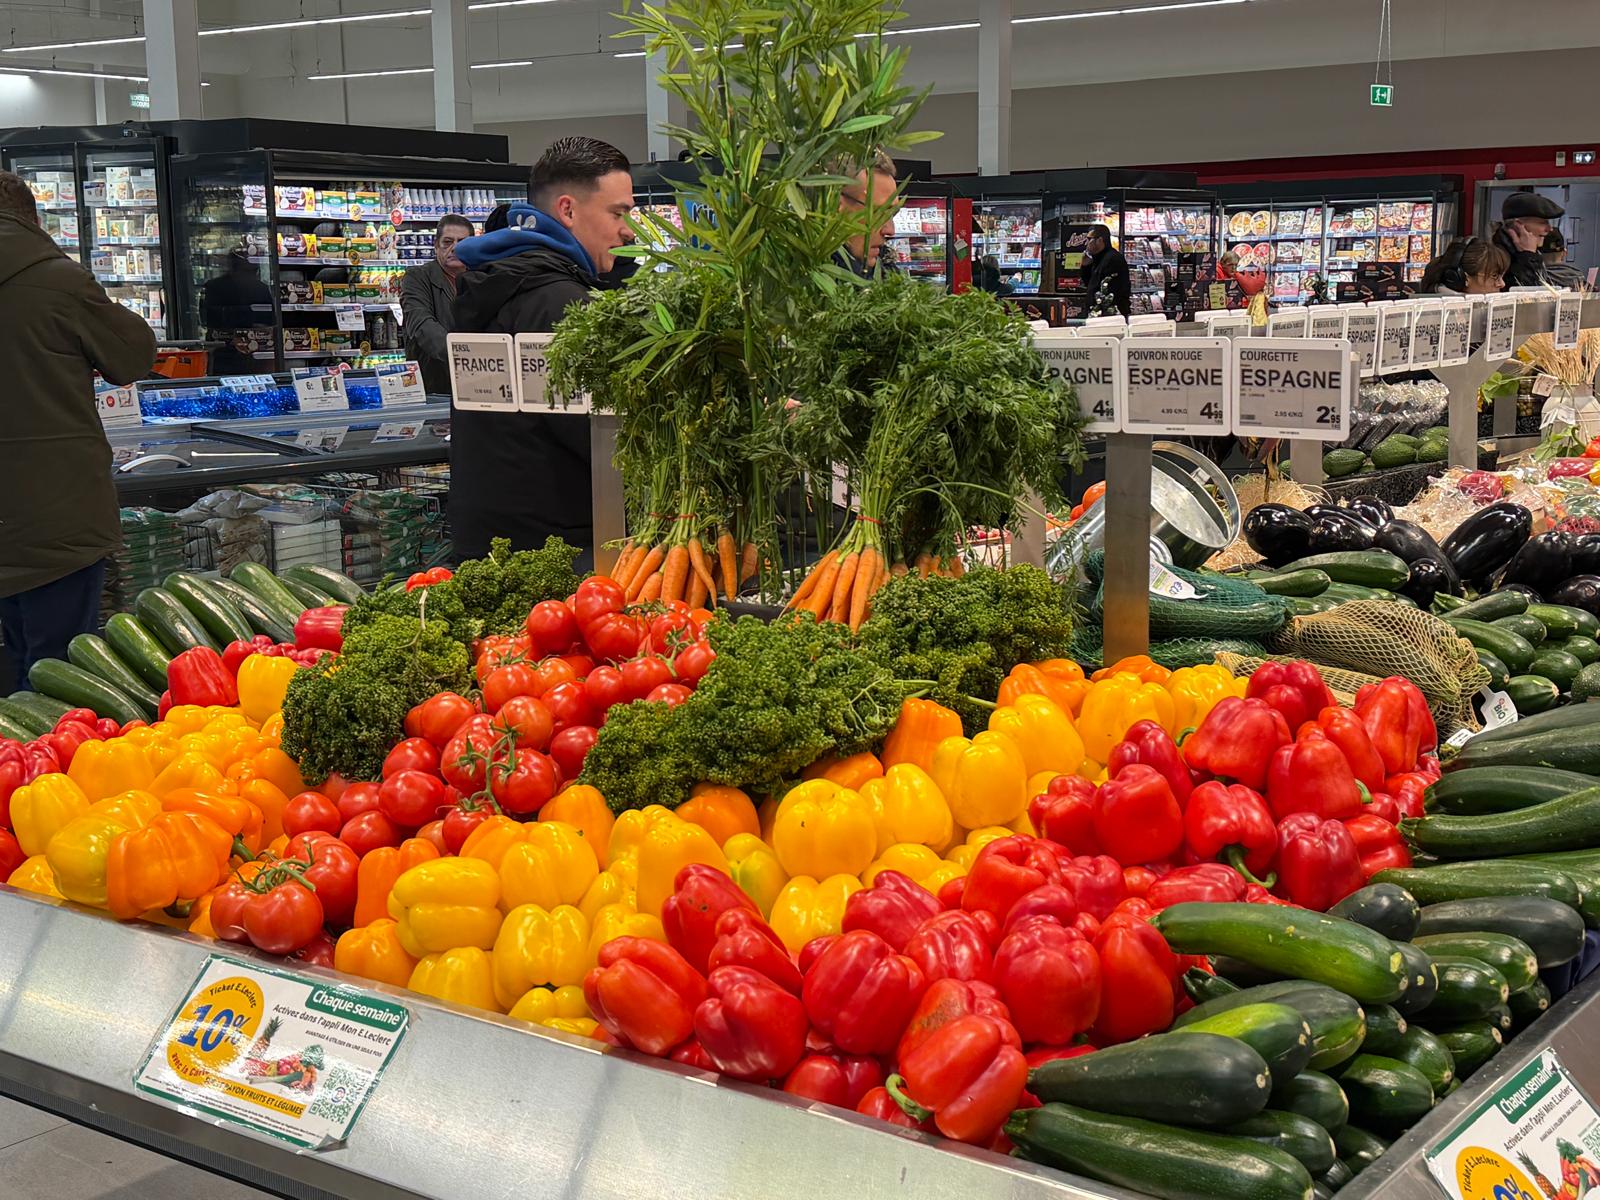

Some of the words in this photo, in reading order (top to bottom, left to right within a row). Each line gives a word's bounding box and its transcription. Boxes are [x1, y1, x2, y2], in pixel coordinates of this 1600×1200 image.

[1348, 330, 1376, 344] ESPAGNE
[1064, 350, 1091, 361] JAUNE
[1128, 350, 1168, 361] POIVRON
[1171, 350, 1202, 361] ROUGE
[1240, 350, 1299, 362] COURGETTE
[454, 357, 505, 372] FRANCE
[1129, 368, 1223, 386] ESPAGNE
[1241, 368, 1341, 390] ESPAGNE
[1494, 704, 1506, 720] BIO
[209, 983, 235, 996] Ticket
[312, 989, 354, 1012] Chaque
[354, 1001, 401, 1026] semaine
[177, 1004, 252, 1052] 10%
[272, 1004, 300, 1018] Activez
[299, 1011, 317, 1024] dans
[317, 1015, 341, 1031] l'appli
[340, 1022, 358, 1036] Mon
[358, 1028, 392, 1046] E.Leclerc
[245, 1089, 268, 1104] FRUITS
[265, 1096, 276, 1105] ET
[1499, 1085, 1530, 1115] Chaque
[1503, 1132, 1524, 1152] Activez
[1519, 1122, 1534, 1137] dans
[1541, 1101, 1556, 1114] Mon
[1462, 1164, 1473, 1193] Ticket
